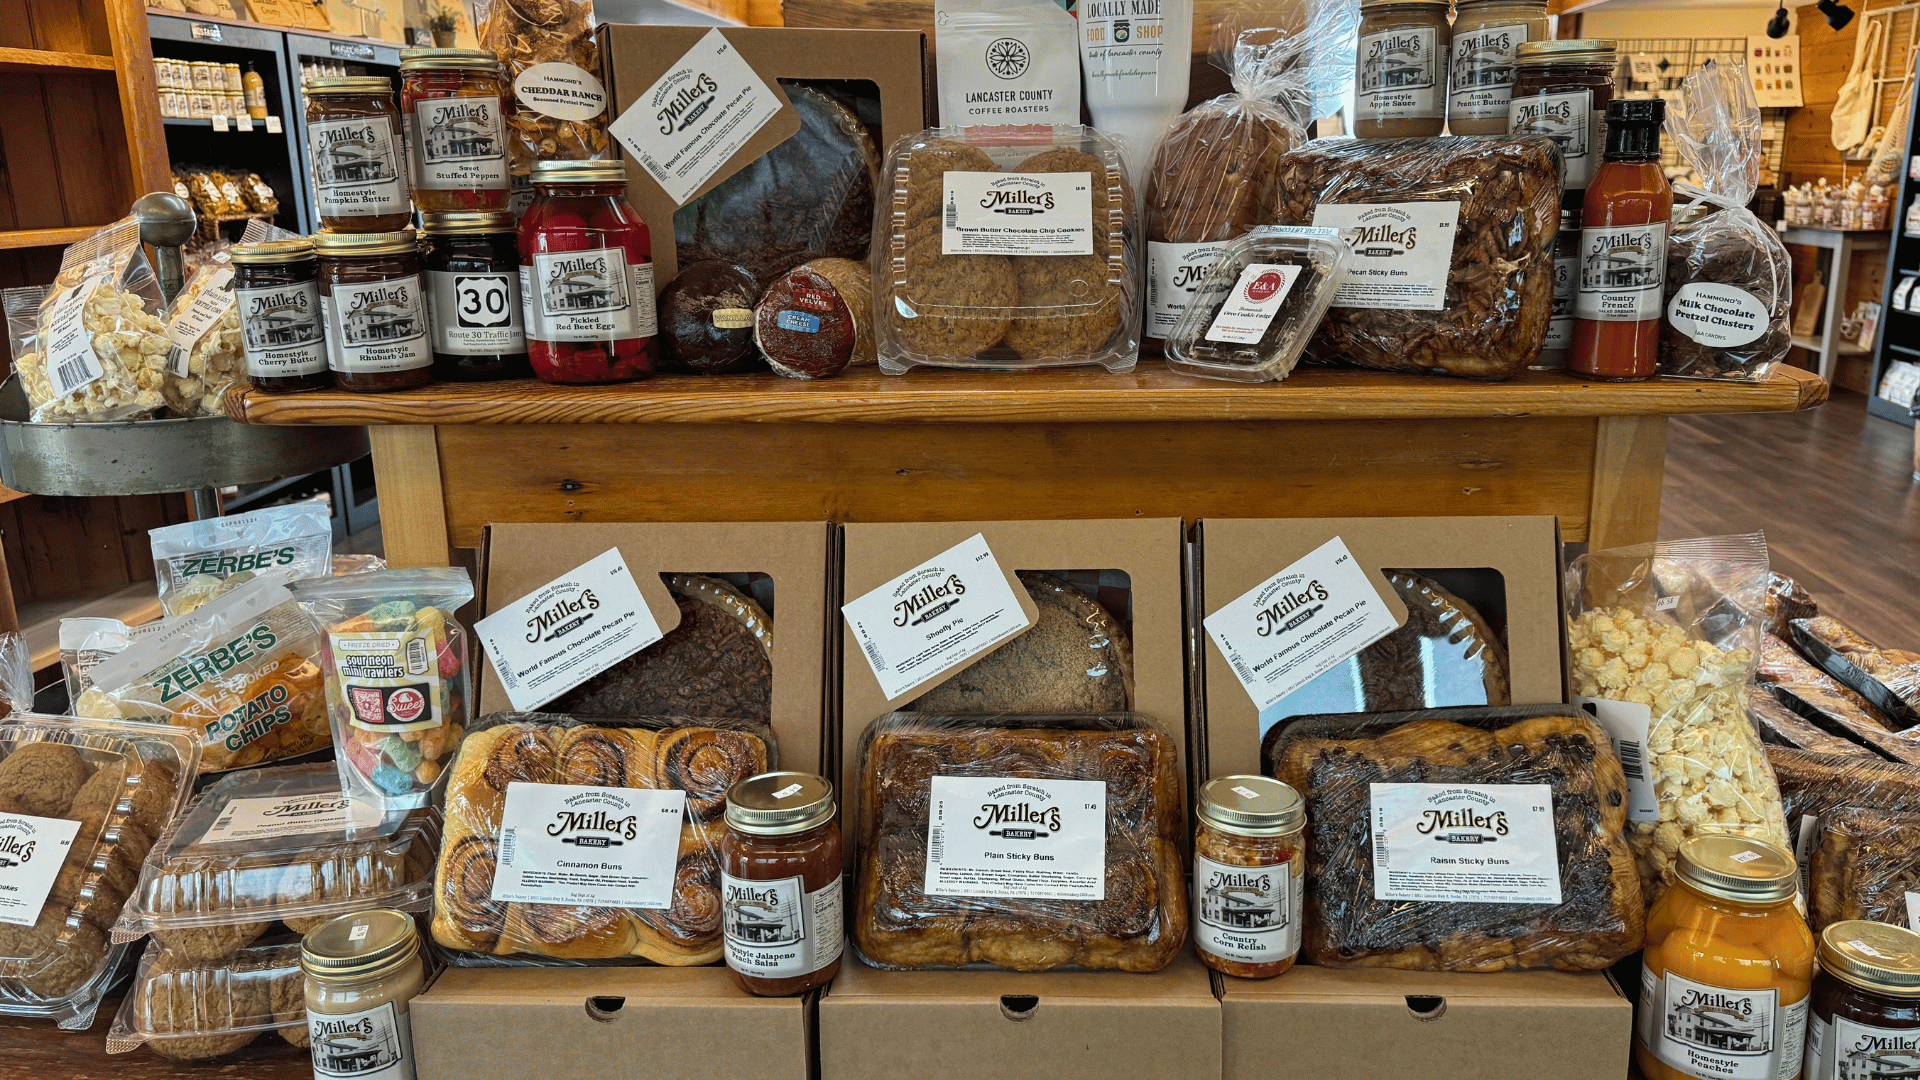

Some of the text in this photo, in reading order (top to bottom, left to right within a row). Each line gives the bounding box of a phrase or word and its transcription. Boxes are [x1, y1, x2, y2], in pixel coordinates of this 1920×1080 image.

[1087, 0, 1160, 18] LOCALLY MADE
[1087, 25, 1163, 41] FOOD SHOP
[544, 76, 582, 85] HAMMOND'S
[521, 86, 602, 101] CHEDDAR RANCH
[966, 90, 1053, 103] LANCASTER COUNTY
[1373, 94, 1412, 102] Homestyle
[1370, 100, 1391, 108] Apple
[664, 85, 752, 170] World Famous Chocolate Pecan Pie
[325, 197, 359, 205] Pumpkin
[1347, 268, 1366, 276] Pecan
[463, 288, 505, 314] 30
[800, 298, 827, 307] VELVET
[1601, 294, 1635, 303] Country
[1601, 301, 1633, 309] French
[1695, 292, 1742, 305] HAMMOND'S
[1679, 298, 1755, 320] Milk Chocolate
[596, 323, 616, 331] Eggs
[1675, 310, 1755, 331] Pretzel Clusters
[449, 331, 470, 339] Route
[483, 331, 509, 339] Traffic
[509, 331, 522, 339] Jam
[265, 350, 309, 359] Homestyle
[366, 346, 409, 354] Homestyle
[399, 351, 416, 359] Jam
[258, 356, 317, 366] Cherry Butter
[182, 547, 294, 578] ZERBE'S
[975, 552, 989, 562] $12.99
[893, 574, 966, 627] Miller's
[1257, 579, 1328, 637] Miller's
[525, 588, 600, 643] Miller's
[926, 617, 964, 641] Shoofly Pie
[1252, 599, 1367, 673] World Famous Chocolate Pecan Pie
[517, 610, 635, 679] World Famous Chocolate Pecan Pie
[152, 625, 277, 704] ZERBE'S
[347, 655, 394, 666] sour neon
[342, 666, 404, 678] mini crawlers
[182, 689, 227, 719] KETTLE
[205, 684, 288, 741] POTATO
[225, 705, 292, 752] CHIPS
[564, 792, 584, 805] Baked
[602, 792, 625, 803] Scratch
[570, 797, 625, 811] Lancaster County
[973, 802, 1062, 832] Miller's
[1417, 808, 1509, 836] Miller's
[547, 811, 637, 840] Miller's
[1006, 852, 1031, 862] Sticky
[1033, 853, 1055, 861] Buns
[1458, 857, 1484, 865] Sticky
[557, 860, 622, 870] Cinnamon Buns
[1214, 936, 1234, 948] Corn
[1223, 932, 1257, 943] Country
[732, 952, 752, 964] Peach
[756, 953, 795, 961] Jalapeno
[1687, 1049, 1739, 1067] Homestyle
[1691, 1058, 1734, 1074] Peaches
